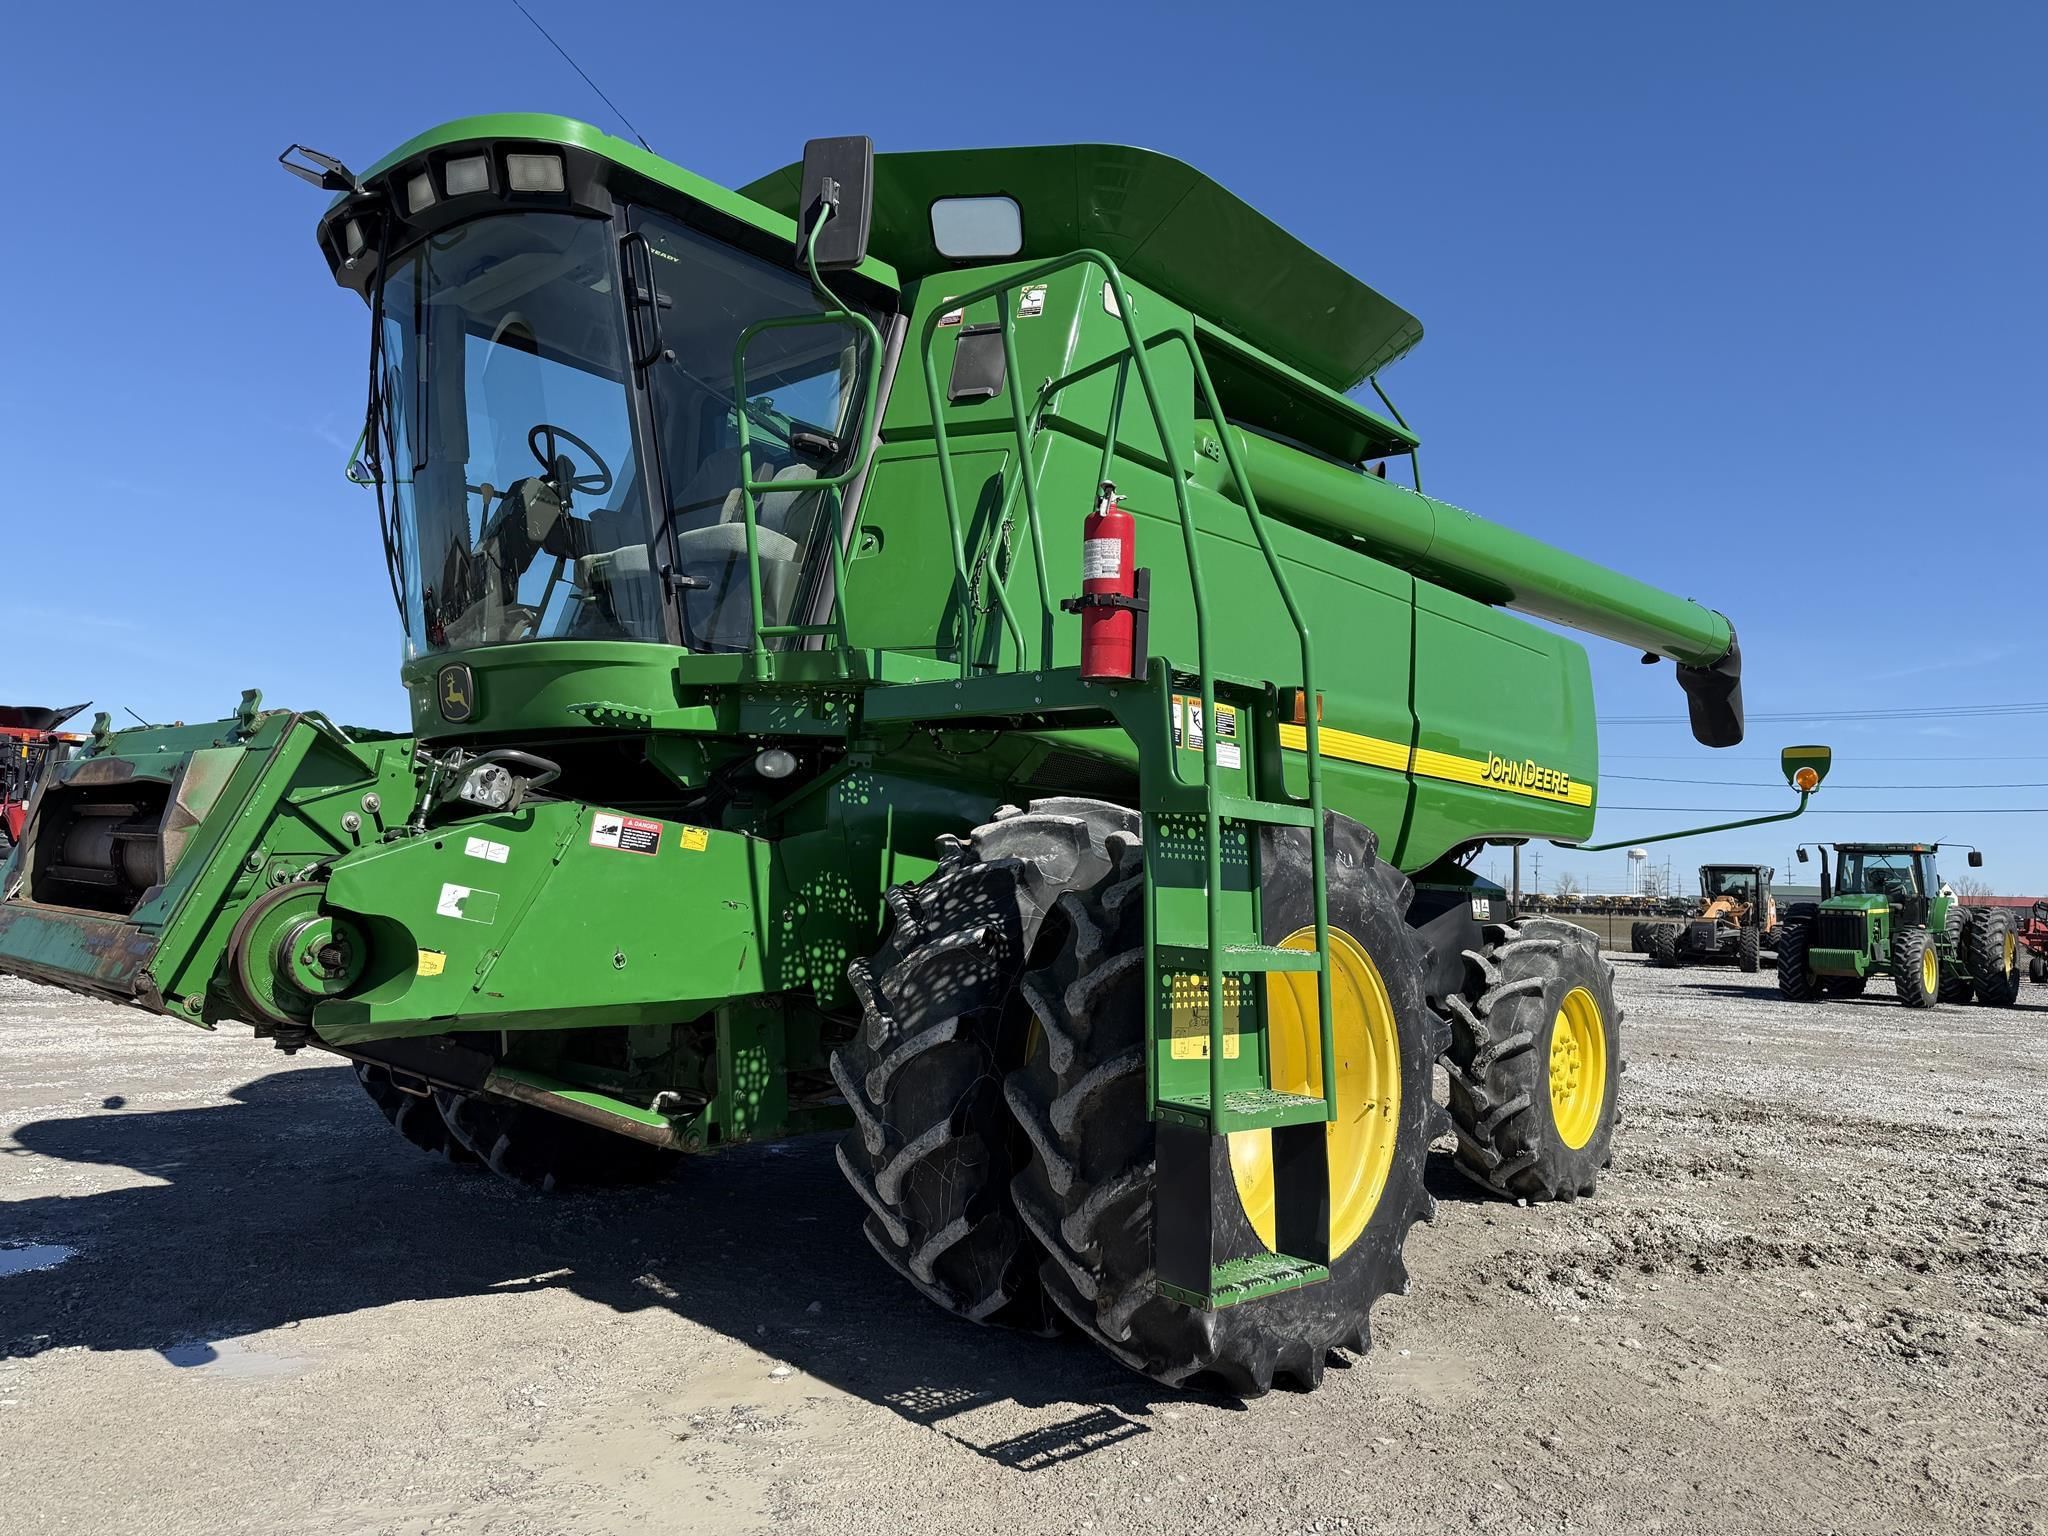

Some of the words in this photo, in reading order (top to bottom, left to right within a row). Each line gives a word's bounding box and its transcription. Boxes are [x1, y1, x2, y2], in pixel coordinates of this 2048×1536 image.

[1481, 750, 1523, 787] JOHN
[1523, 759, 1569, 796] DEERE
[634, 821, 658, 831] DANGER
